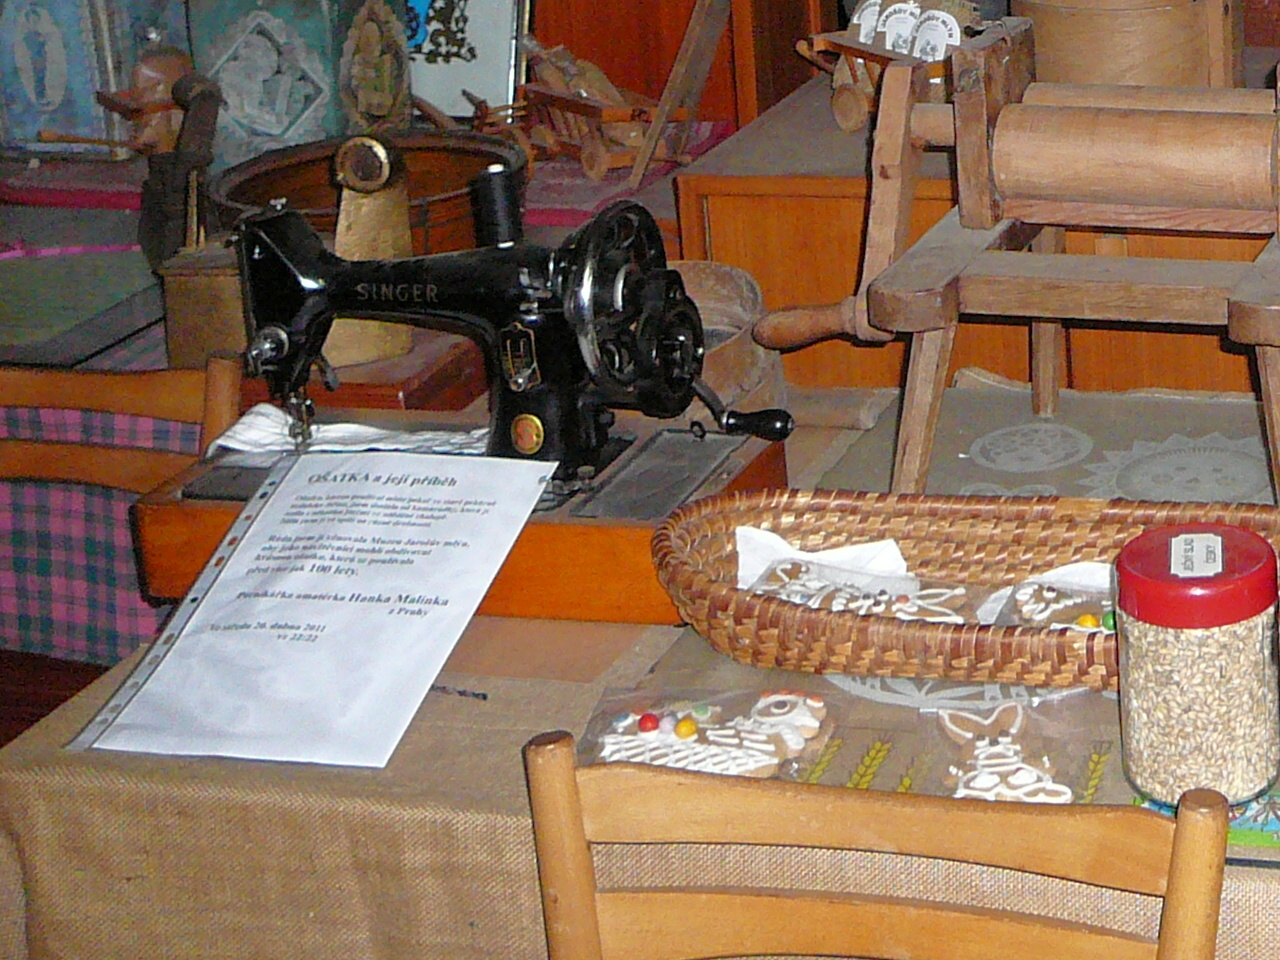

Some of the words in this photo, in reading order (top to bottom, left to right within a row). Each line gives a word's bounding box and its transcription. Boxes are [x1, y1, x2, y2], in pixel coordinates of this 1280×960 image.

[355, 283, 438, 302] SINGER
[308, 562, 332, 573] 100
[348, 593, 391, 604] Hanka
